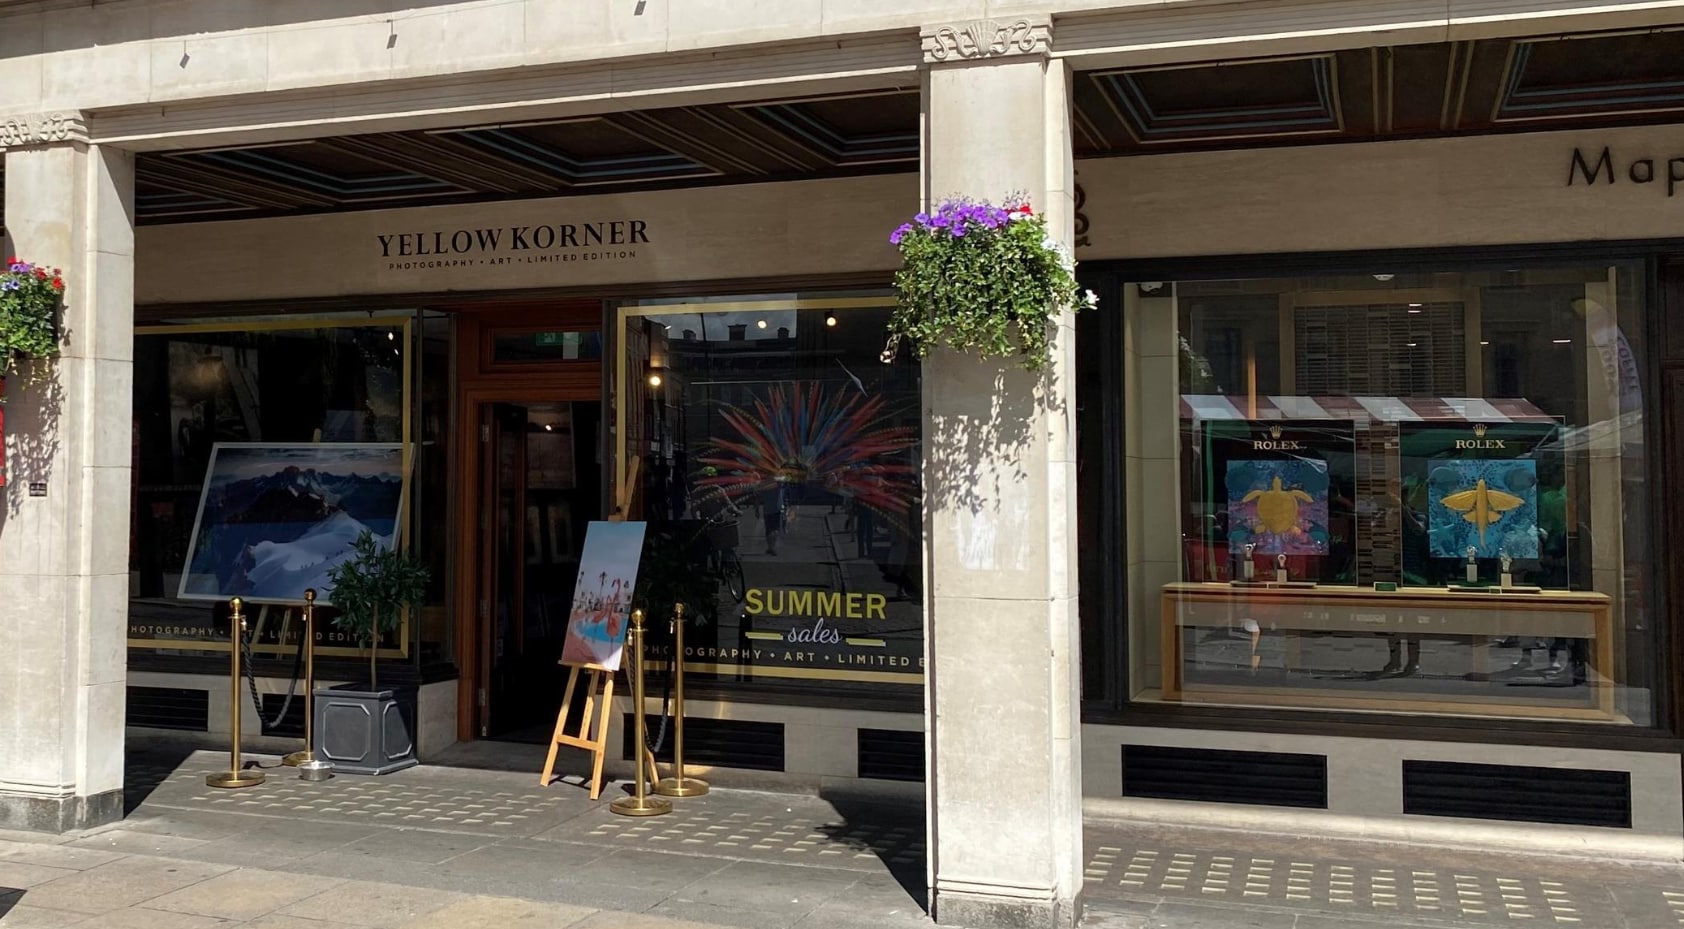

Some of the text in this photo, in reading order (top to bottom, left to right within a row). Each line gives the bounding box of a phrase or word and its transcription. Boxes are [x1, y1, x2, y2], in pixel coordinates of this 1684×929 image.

[377, 219, 650, 258] YELLOW KORNER
[388, 250, 637, 271] PHOTOGRAPHY ART LIMITED EDITION
[1253, 440, 1300, 450] ROLEX
[1455, 439, 1506, 449] ROLEX
[744, 588, 888, 620] SUMMER
[787, 617, 843, 645] sales
[643, 644, 762, 660] PHOOGRAPHY
[783, 651, 816, 663] ART
[838, 653, 911, 667] LIMITED
